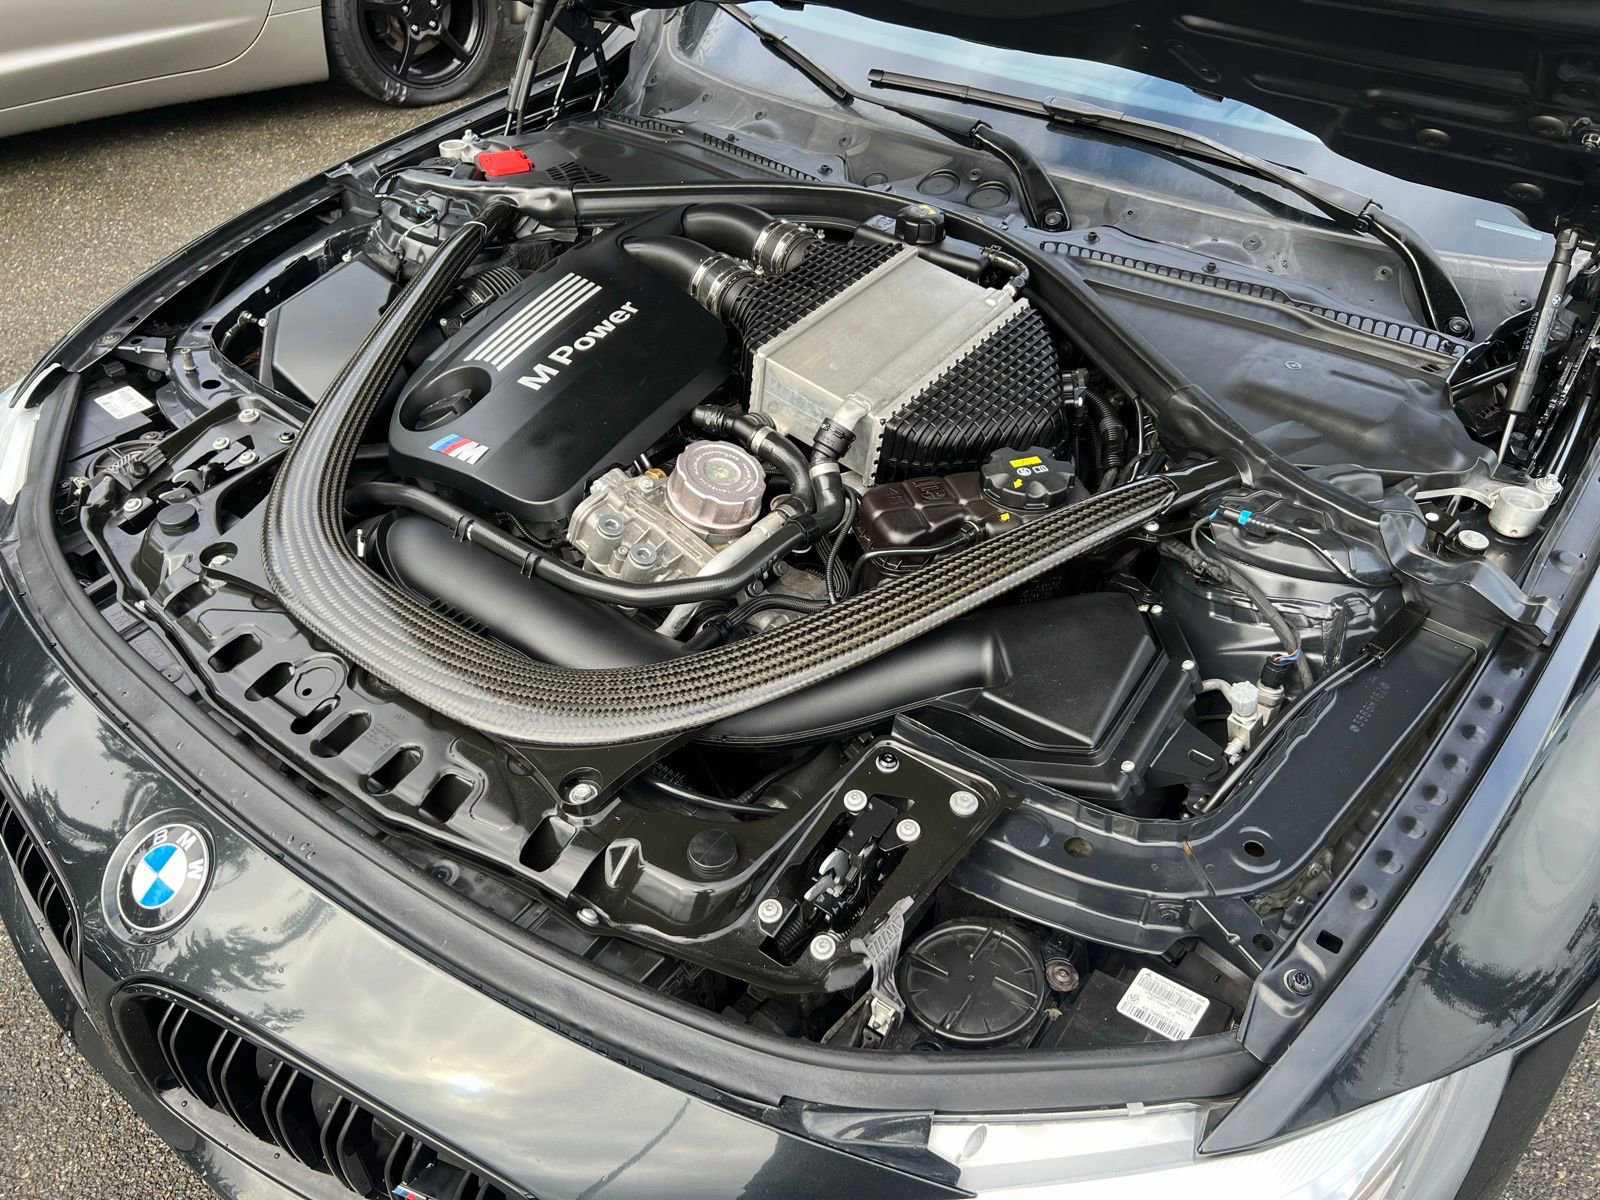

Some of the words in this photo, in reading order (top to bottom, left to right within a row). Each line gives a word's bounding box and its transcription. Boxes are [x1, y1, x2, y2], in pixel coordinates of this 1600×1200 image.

[517, 363, 560, 391] M
[547, 301, 639, 366] Power
[447, 440, 490, 466] M
[152, 828, 204, 880] BMW
